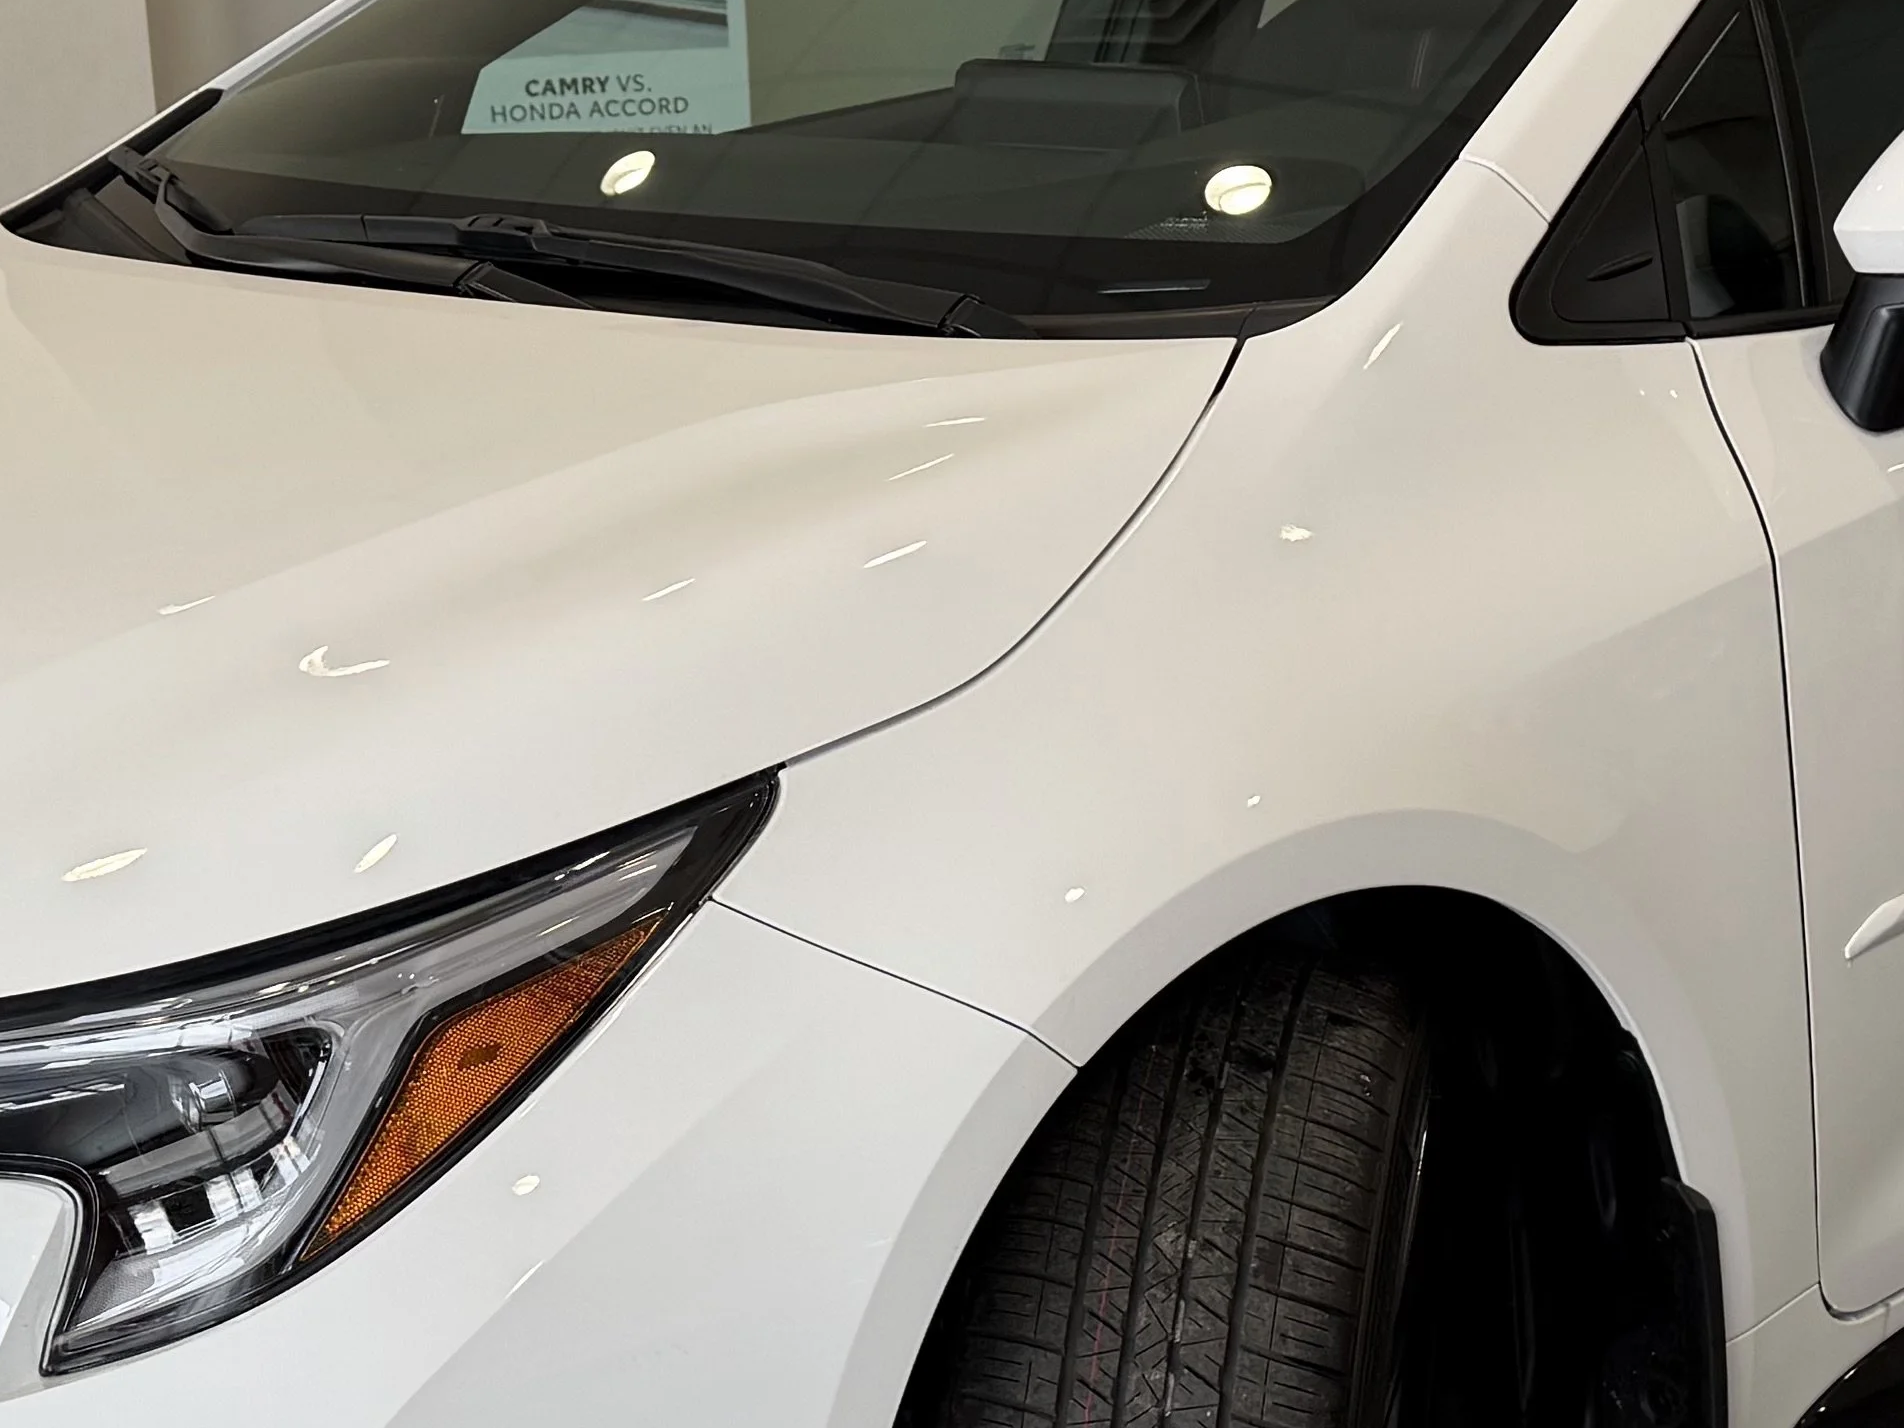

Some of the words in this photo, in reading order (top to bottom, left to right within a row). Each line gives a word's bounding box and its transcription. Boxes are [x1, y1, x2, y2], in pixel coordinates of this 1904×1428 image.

[524, 76, 610, 97] CAMRY
[616, 74, 653, 93] VS.
[490, 102, 580, 124] HONDA
[589, 96, 689, 119] ACCORD
